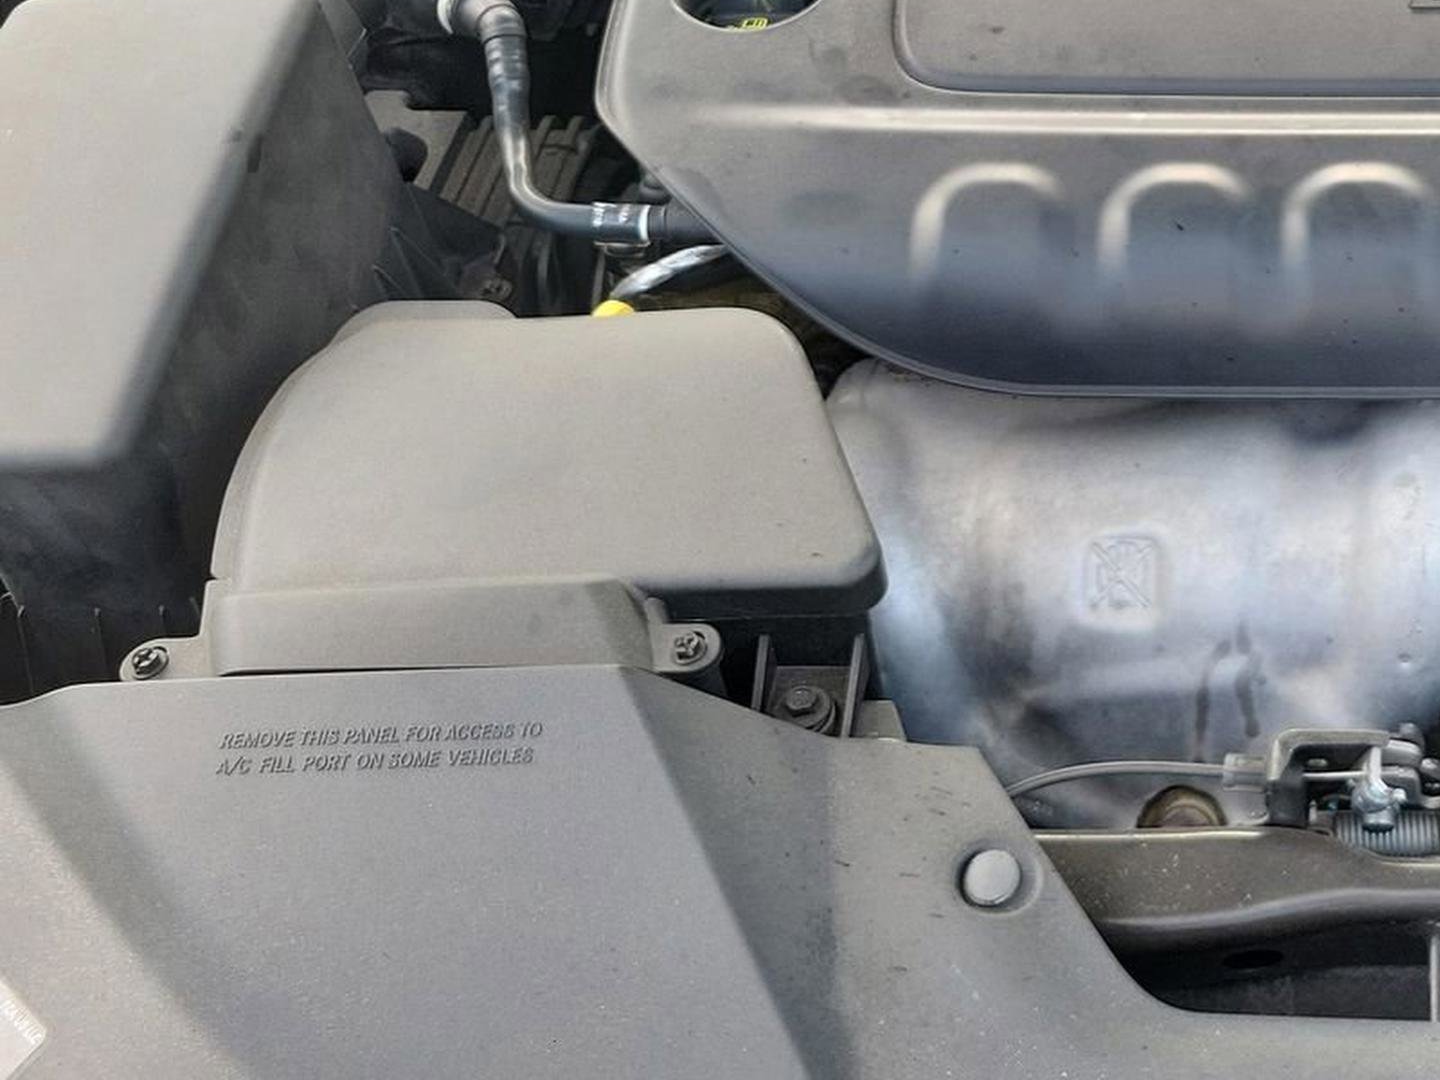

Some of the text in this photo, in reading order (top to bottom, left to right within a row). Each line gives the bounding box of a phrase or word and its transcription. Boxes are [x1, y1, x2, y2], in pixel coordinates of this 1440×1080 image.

[219, 722, 544, 749] REMOVE THIS PANEL FOR ACCESS TO
[216, 747, 535, 776] A/C FILL PORT ON SOME VEHICLES
